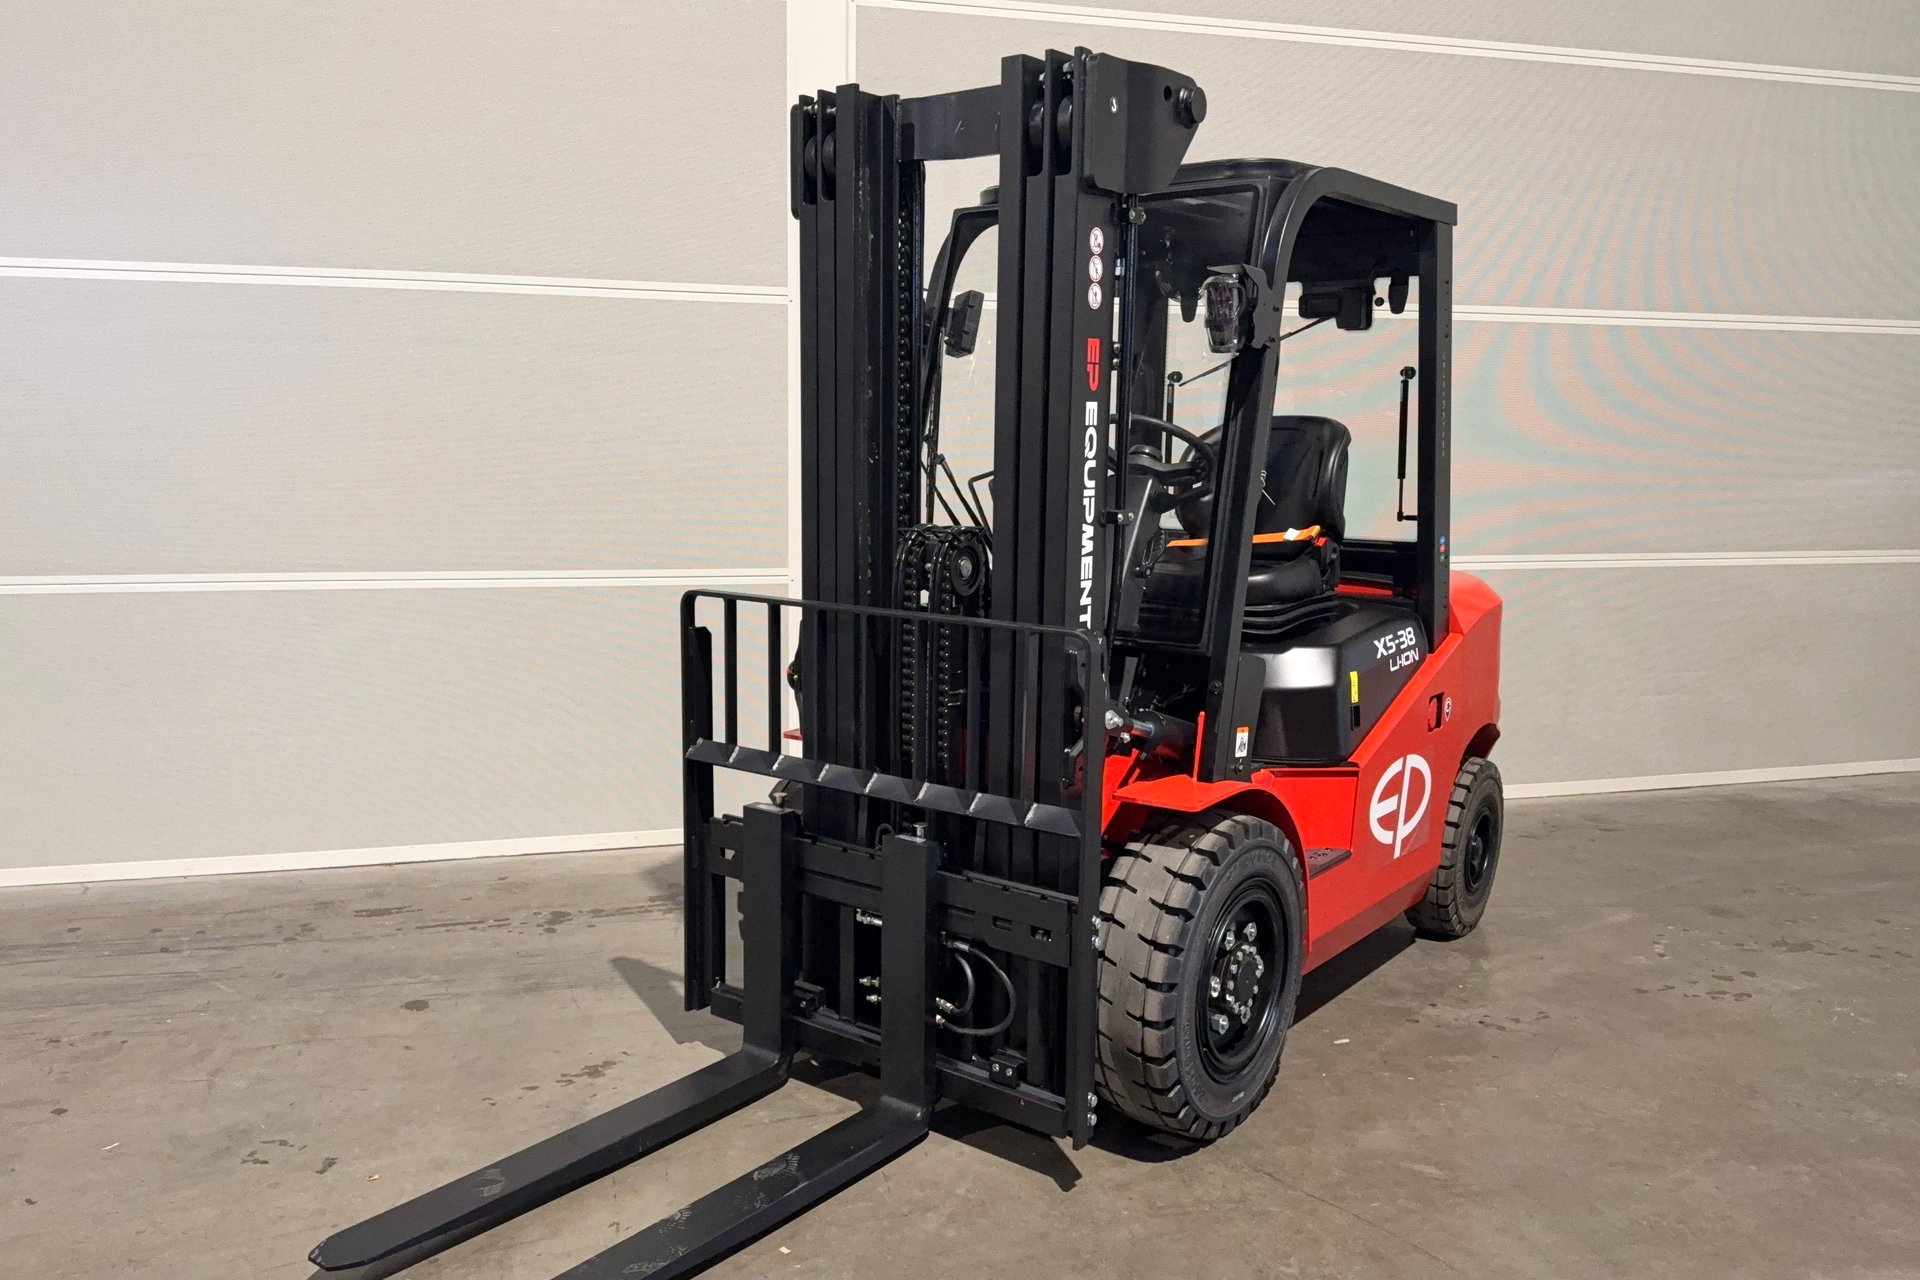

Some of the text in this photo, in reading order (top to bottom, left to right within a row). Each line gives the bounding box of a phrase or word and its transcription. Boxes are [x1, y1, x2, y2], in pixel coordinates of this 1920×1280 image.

[1079, 338, 1100, 629] EP EQUIPMENT
[1373, 627, 1416, 659] X5-38
[1369, 754, 1432, 859] EP
